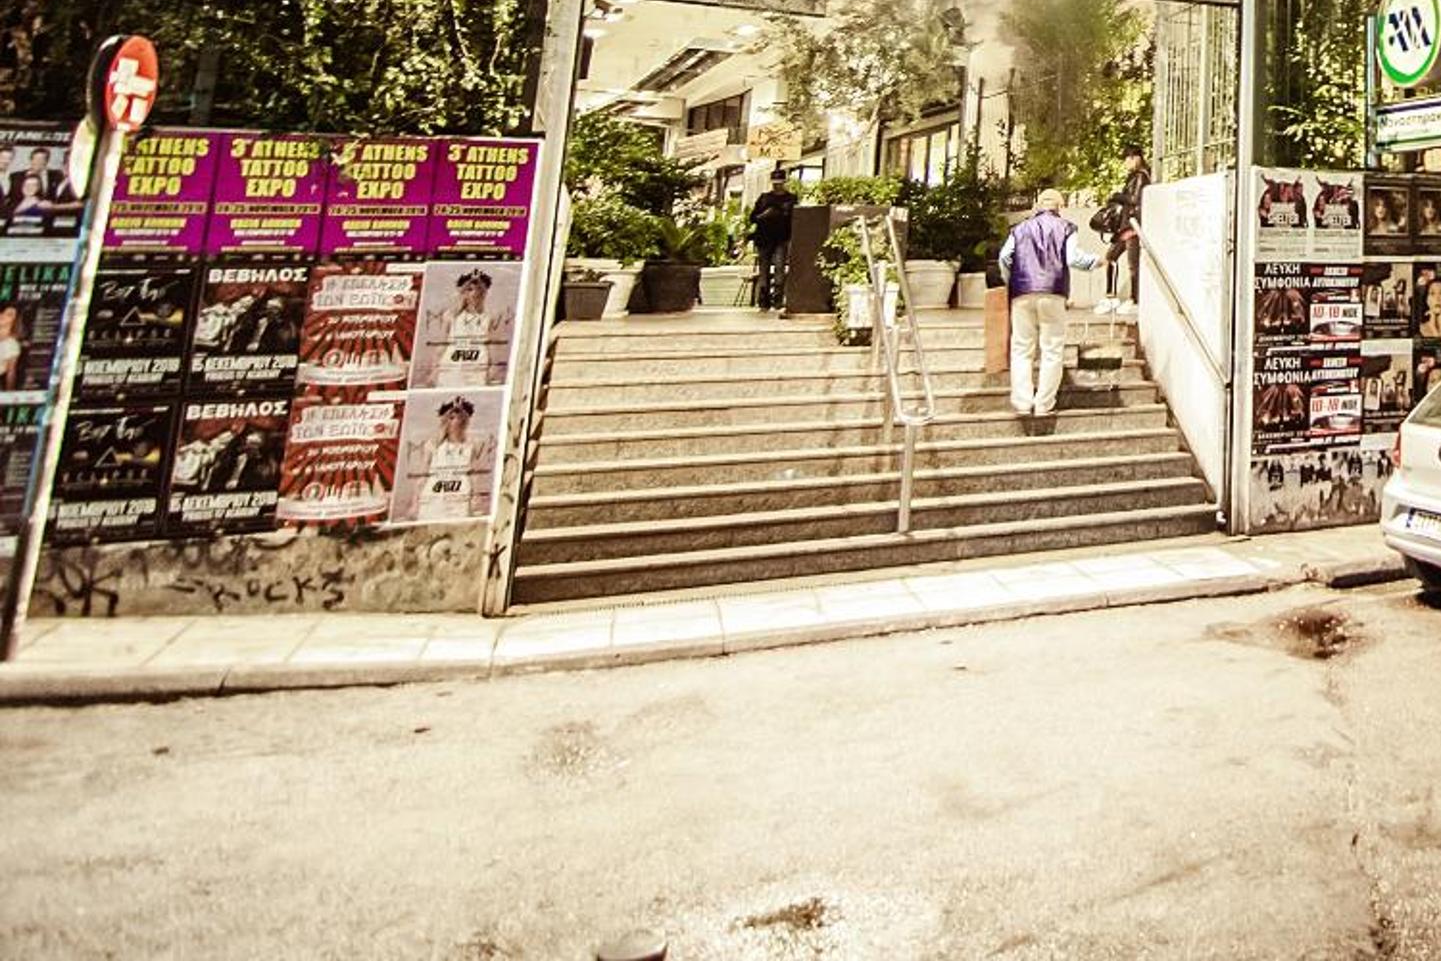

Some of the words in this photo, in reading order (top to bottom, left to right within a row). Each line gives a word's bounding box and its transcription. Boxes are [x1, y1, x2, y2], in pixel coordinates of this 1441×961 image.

[252, 140, 320, 159] ATHENS
[361, 144, 429, 161] ATHENS
[466, 146, 529, 164] ATHENS
[241, 159, 309, 177] TATTOO
[457, 165, 518, 182] TATTOO
[128, 176, 182, 195] EXPO
[246, 179, 297, 197] EXPO
[356, 182, 404, 199] EXPO
[460, 183, 506, 200] EXPO
[208, 267, 308, 284] ΒΕΒΗΛΟΣ
[1264, 263, 1300, 275] ΛΕΥΚΗ
[1264, 357, 1301, 370] ΛΕΥΚΗ
[186, 401, 288, 420] ΒΕΒΗΛΟΣ
